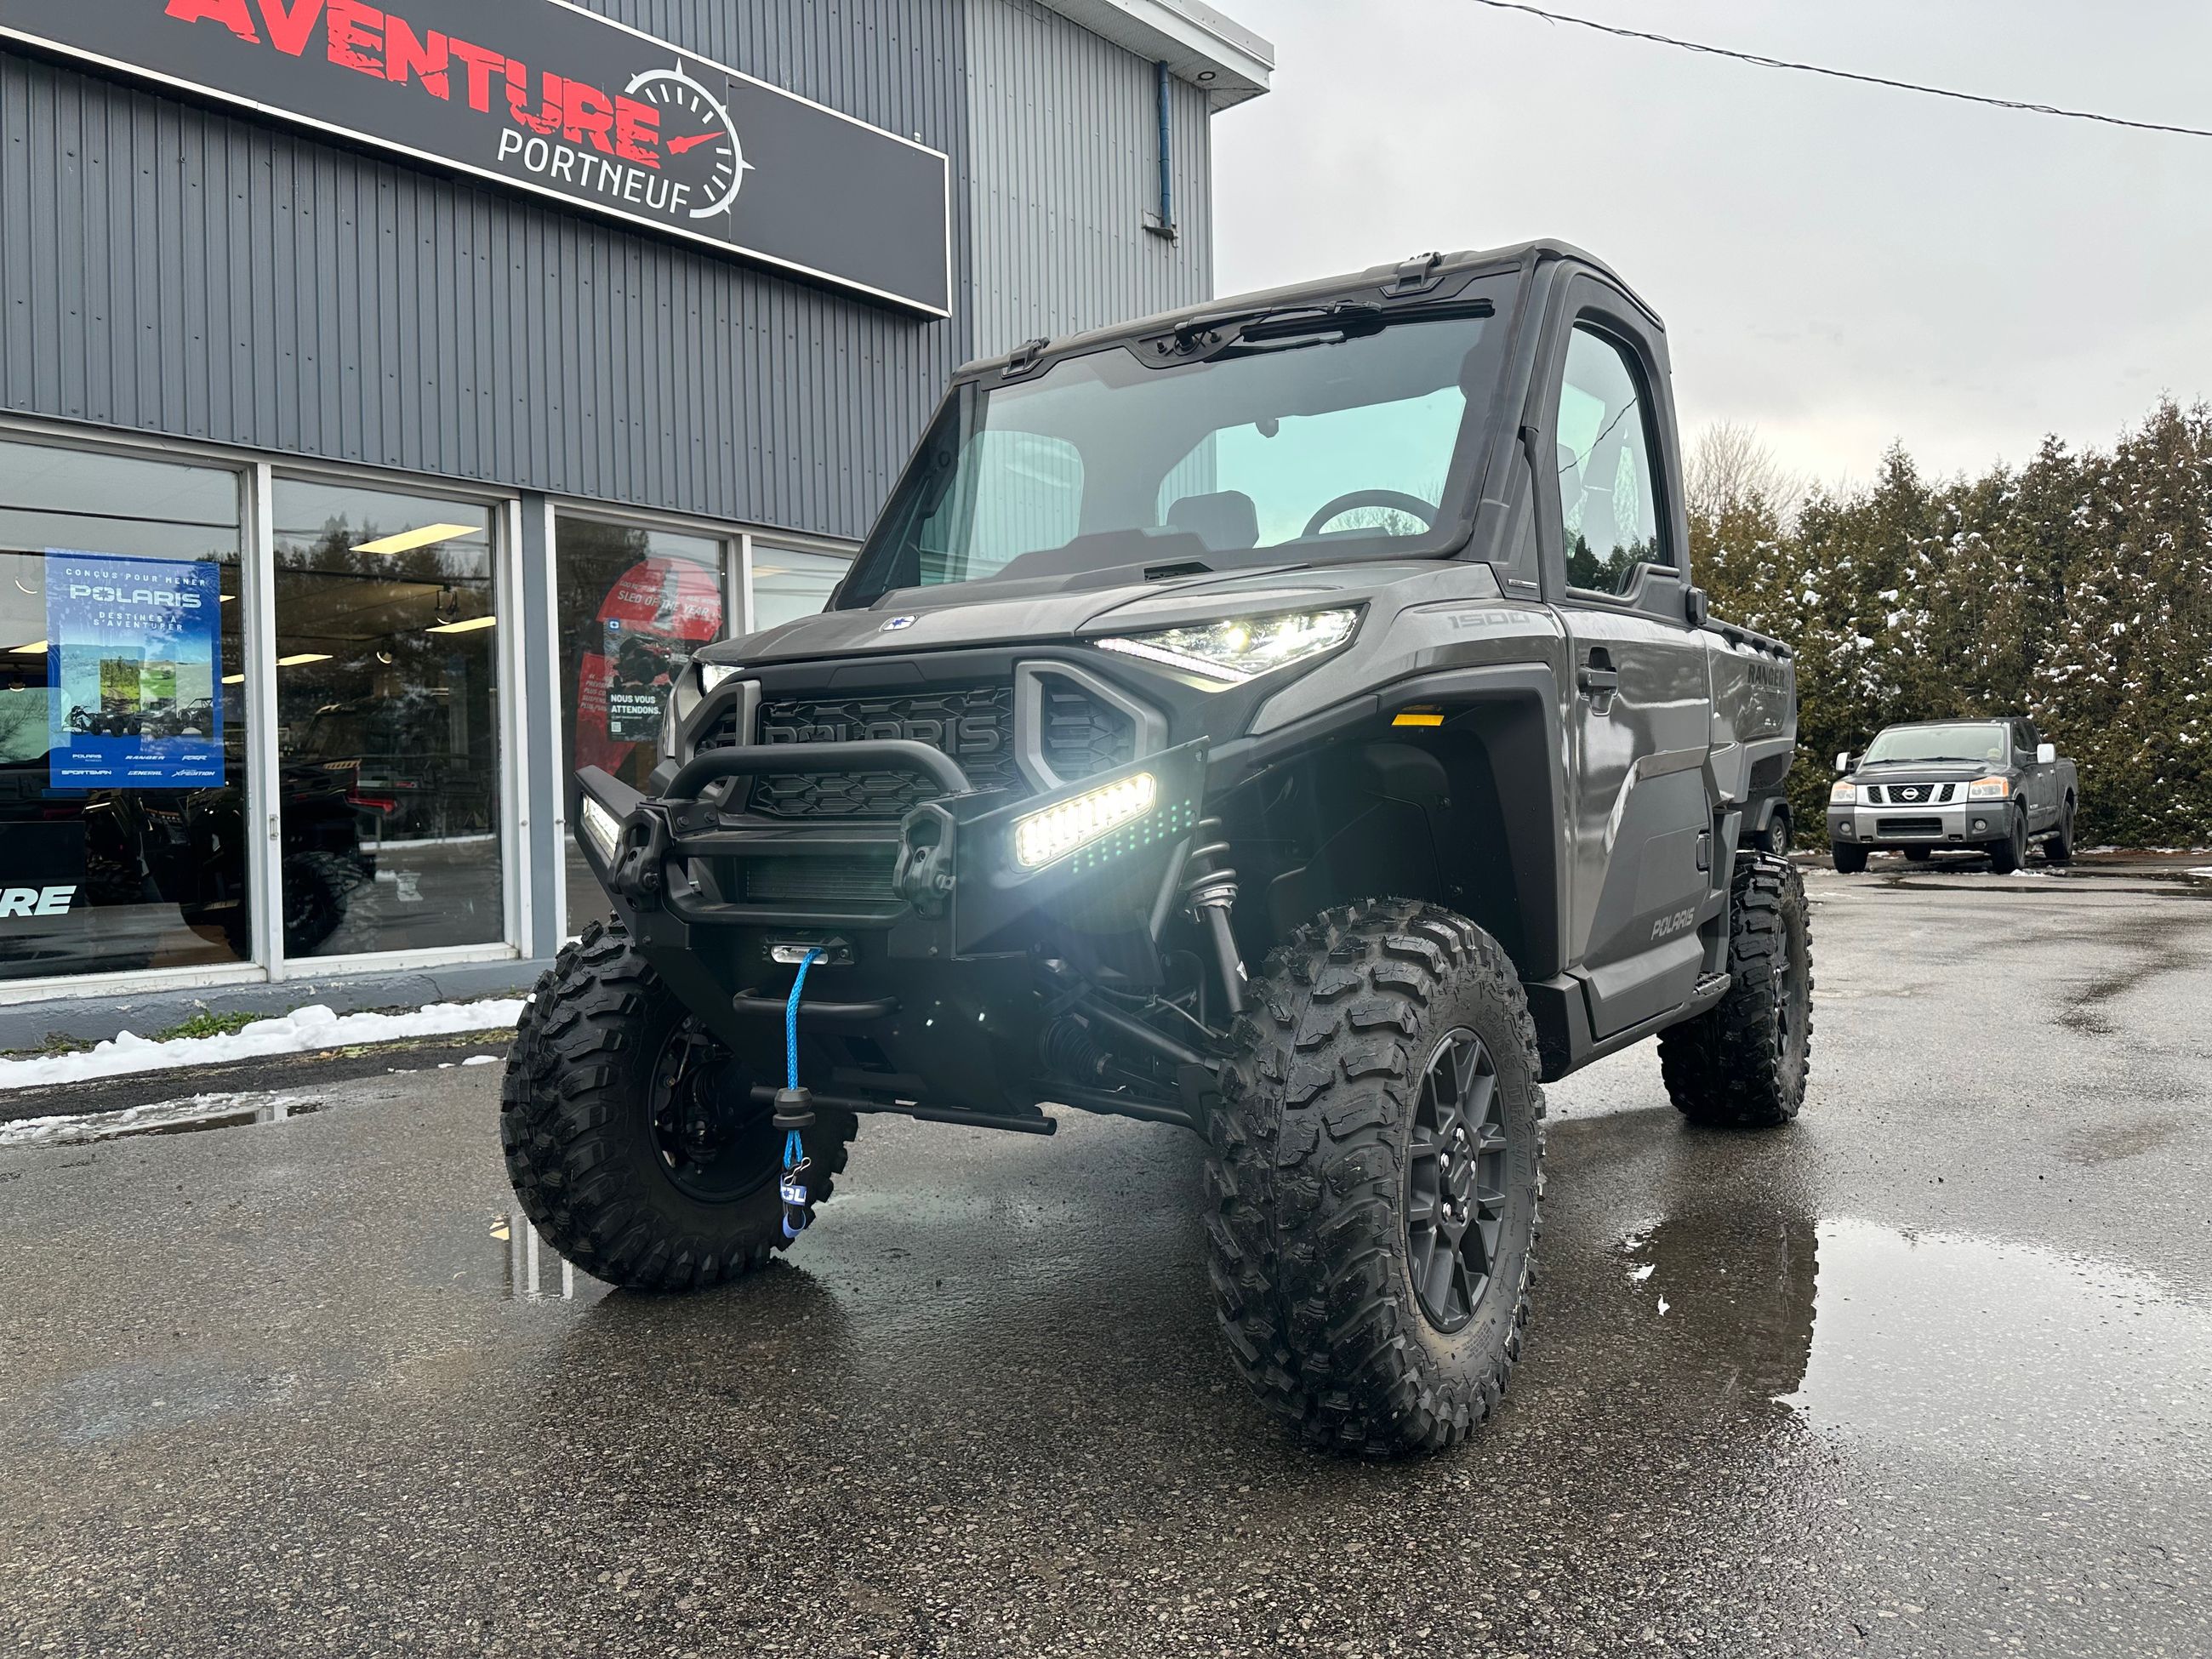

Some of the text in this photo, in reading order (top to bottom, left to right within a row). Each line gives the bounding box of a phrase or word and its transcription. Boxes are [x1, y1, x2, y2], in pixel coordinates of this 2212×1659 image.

[496, 127, 691, 214] PORTNEUF
[66, 567, 206, 586] CONÇUS POUR MENER
[69, 584, 202, 608] POLARIS
[617, 590, 641, 604] SLED
[644, 596, 658, 607] OF
[660, 600, 680, 612] THE
[683, 603, 710, 616] YEAR
[1447, 612, 1530, 630] 1500
[1747, 664, 1785, 687] RANGER
[610, 694, 656, 704] NOUS VOUS
[611, 704, 662, 715] ATTENDONS.
[0, 886, 77, 918] RE
[1650, 906, 1695, 941] POLARIS
[1507, 1081, 1529, 1184] TRAIL
